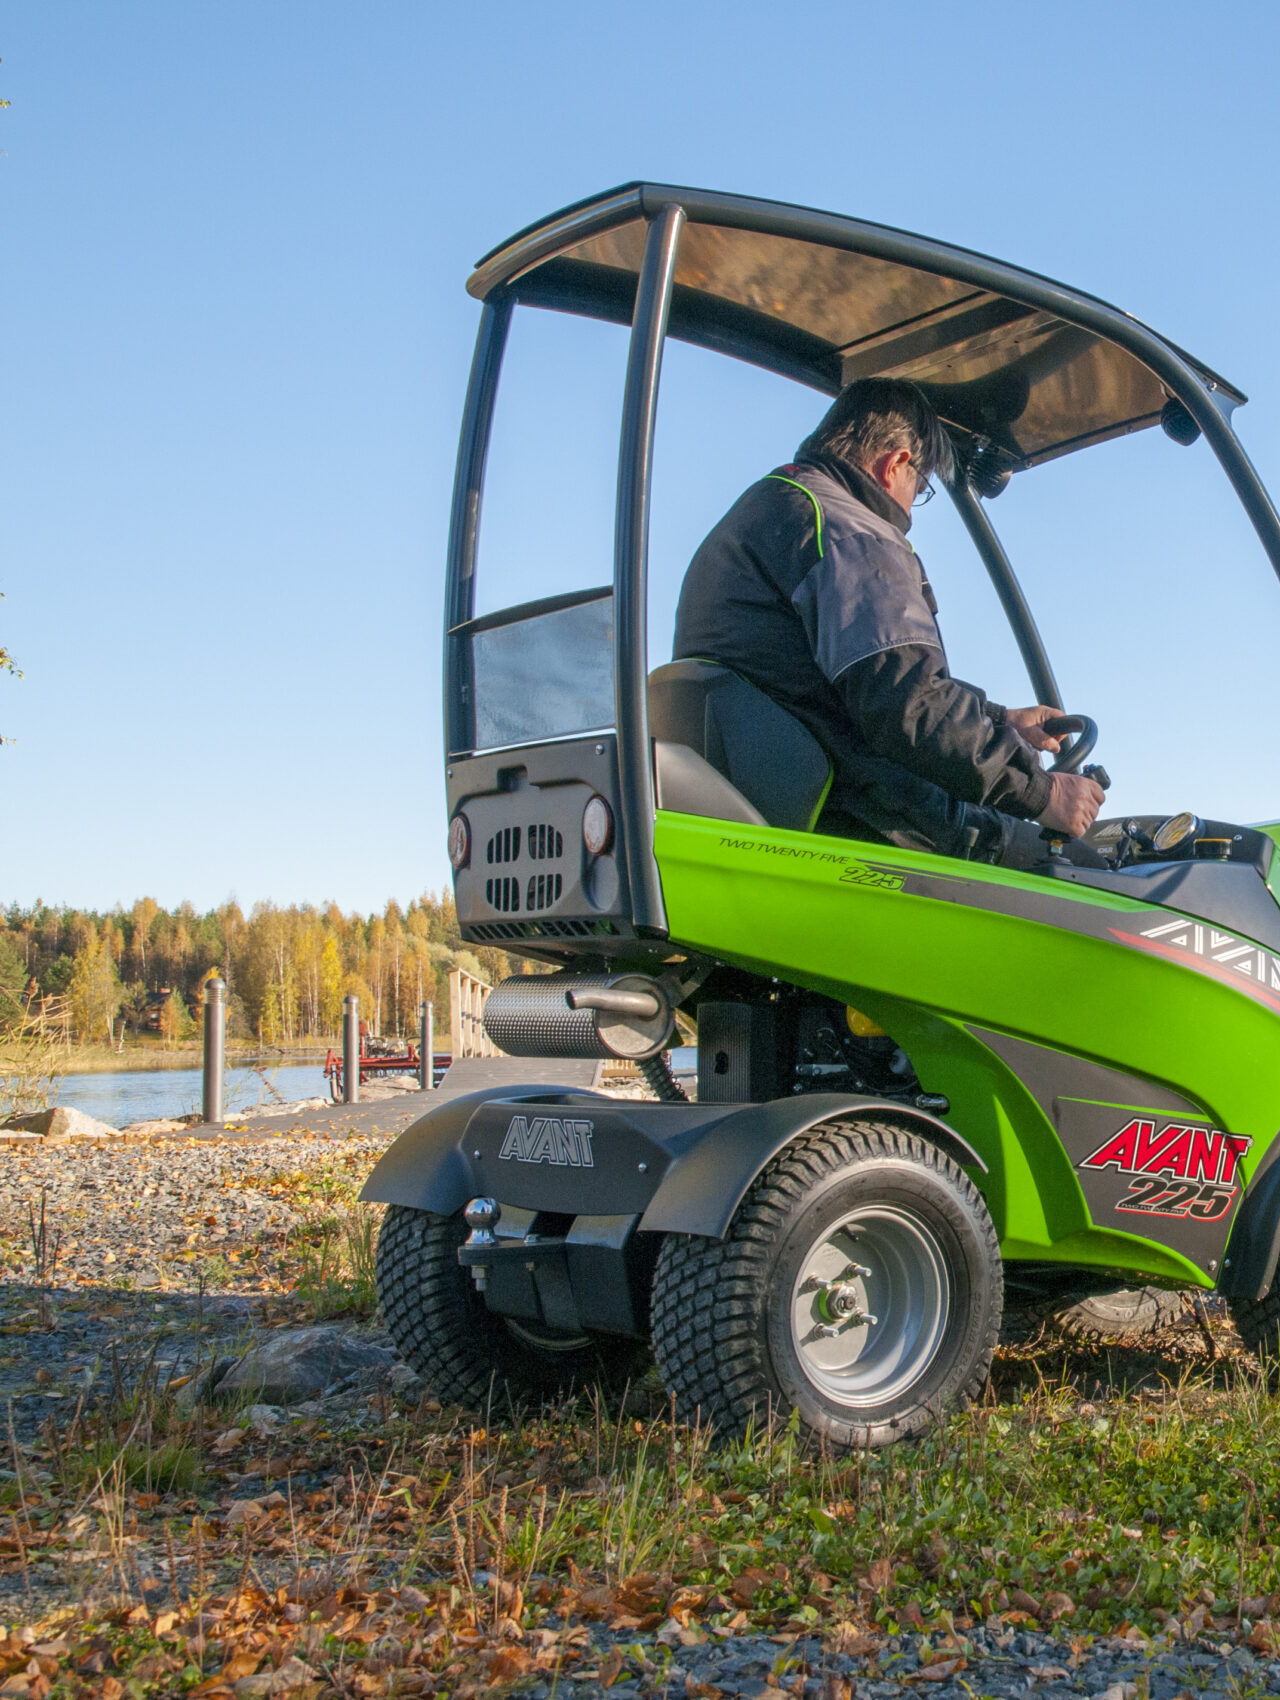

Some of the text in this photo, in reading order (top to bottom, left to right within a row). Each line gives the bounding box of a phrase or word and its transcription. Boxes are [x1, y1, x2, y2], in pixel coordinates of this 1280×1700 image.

[719, 837, 850, 865] TWO TWENTY FIVE
[839, 866, 906, 891] 225
[498, 1115, 594, 1167] AVANT
[1079, 1117, 1254, 1186] AVANT
[1115, 1175, 1239, 1222] 225
